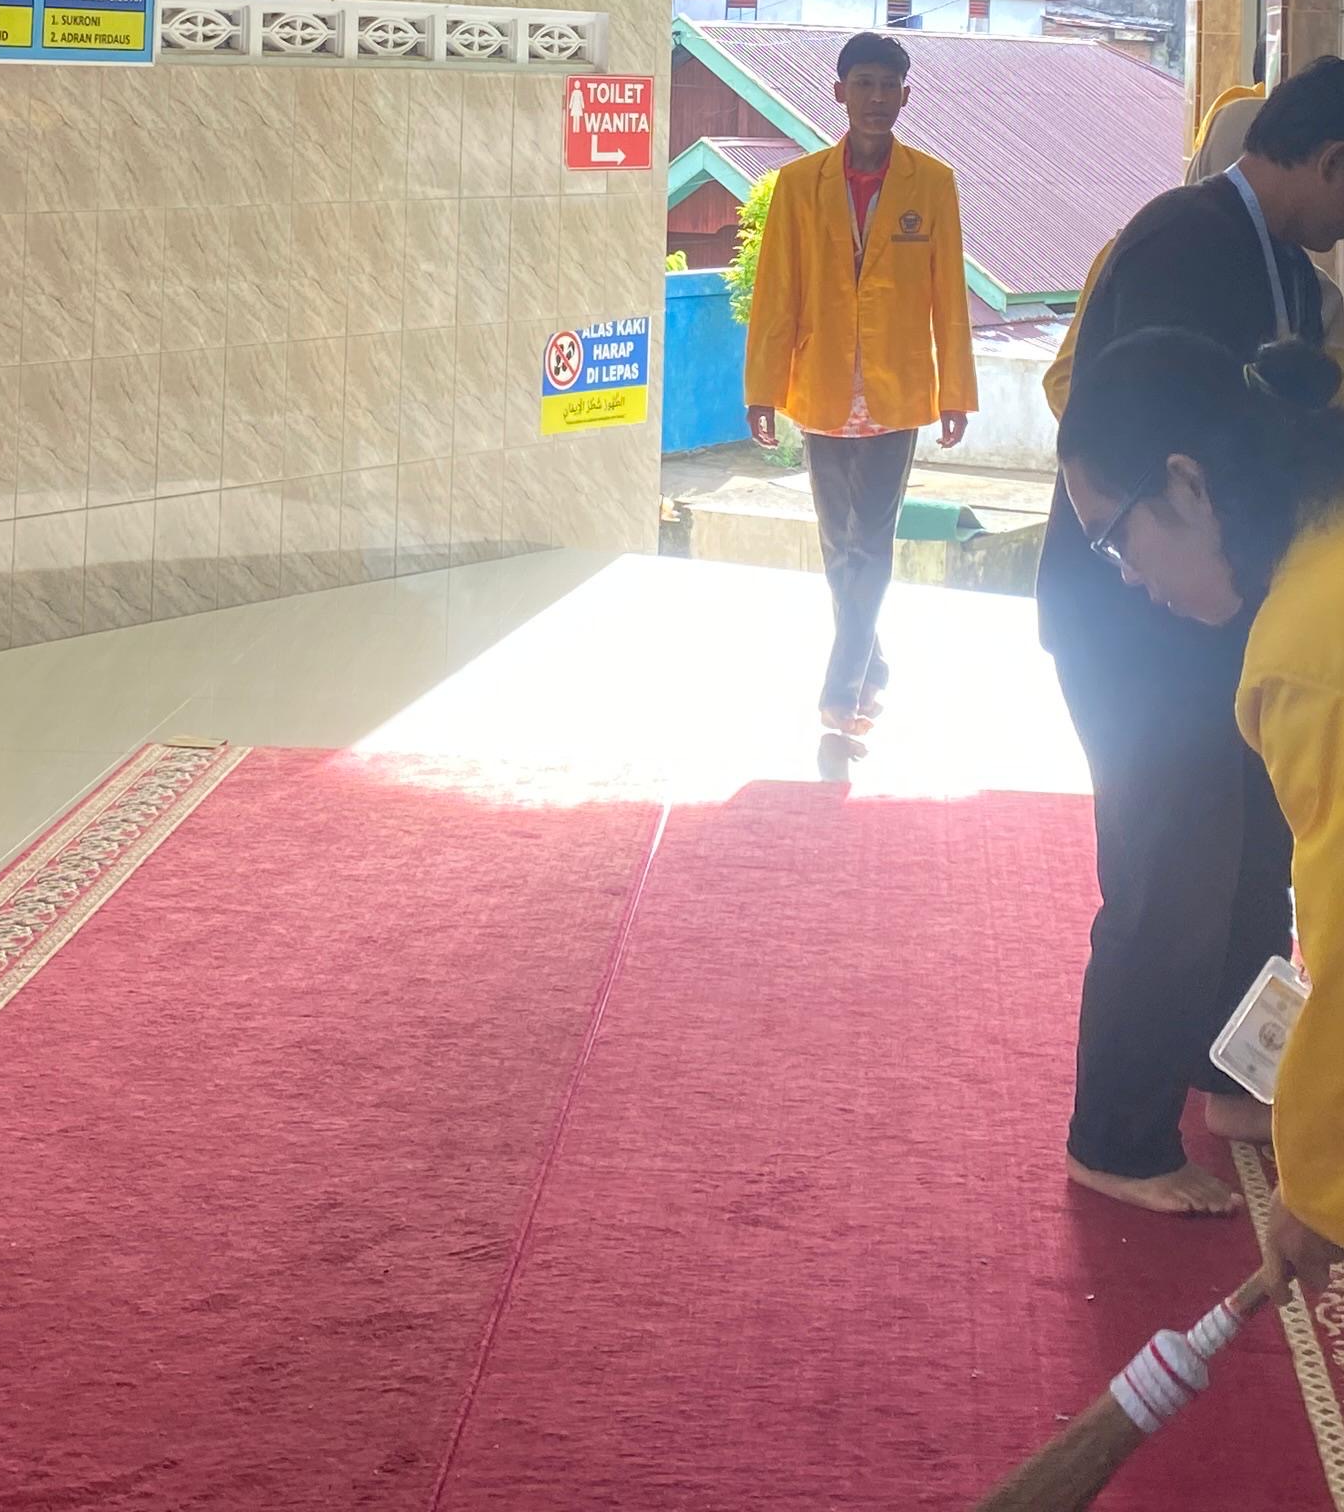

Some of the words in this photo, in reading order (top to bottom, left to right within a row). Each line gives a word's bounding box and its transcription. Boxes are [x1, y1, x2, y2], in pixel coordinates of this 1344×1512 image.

[61, 16, 101, 26] SUKRONI
[61, 33, 92, 43] ADRAN
[94, 34, 130, 45] FIRDAUS
[587, 83, 644, 104] TOILET
[584, 112, 649, 133] WANITA
[582, 321, 613, 339] ALAS
[617, 319, 646, 336] KAKI
[593, 341, 634, 360] HARAP
[587, 367, 598, 384] DI
[602, 363, 639, 382] LEPAS
